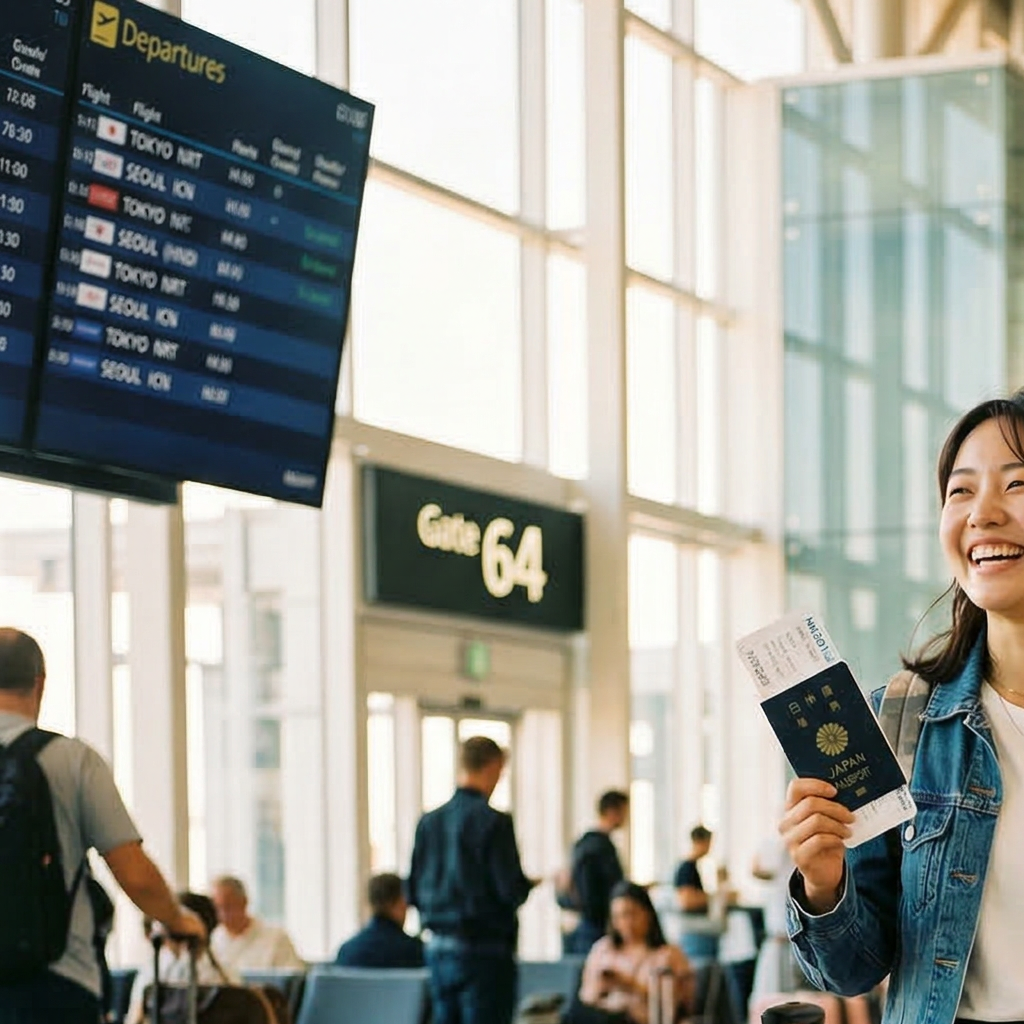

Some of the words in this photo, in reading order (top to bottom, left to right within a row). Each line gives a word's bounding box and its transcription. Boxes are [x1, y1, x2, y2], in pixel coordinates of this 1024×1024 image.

[121, 18, 226, 84] Departures
[130, 129, 174, 160] TOKYO
[126, 162, 167, 192] SEOUL
[123, 196, 167, 225] TOKYO
[118, 228, 159, 257] SEOUL
[115, 261, 158, 289] TOKYO
[109, 293, 149, 321] SEOUL
[106, 326, 149, 354] TOKYO
[100, 359, 142, 386] SEOUL
[416, 502, 481, 557] Gate
[481, 516, 549, 603] 64
[828, 752, 867, 779] JAPAN
